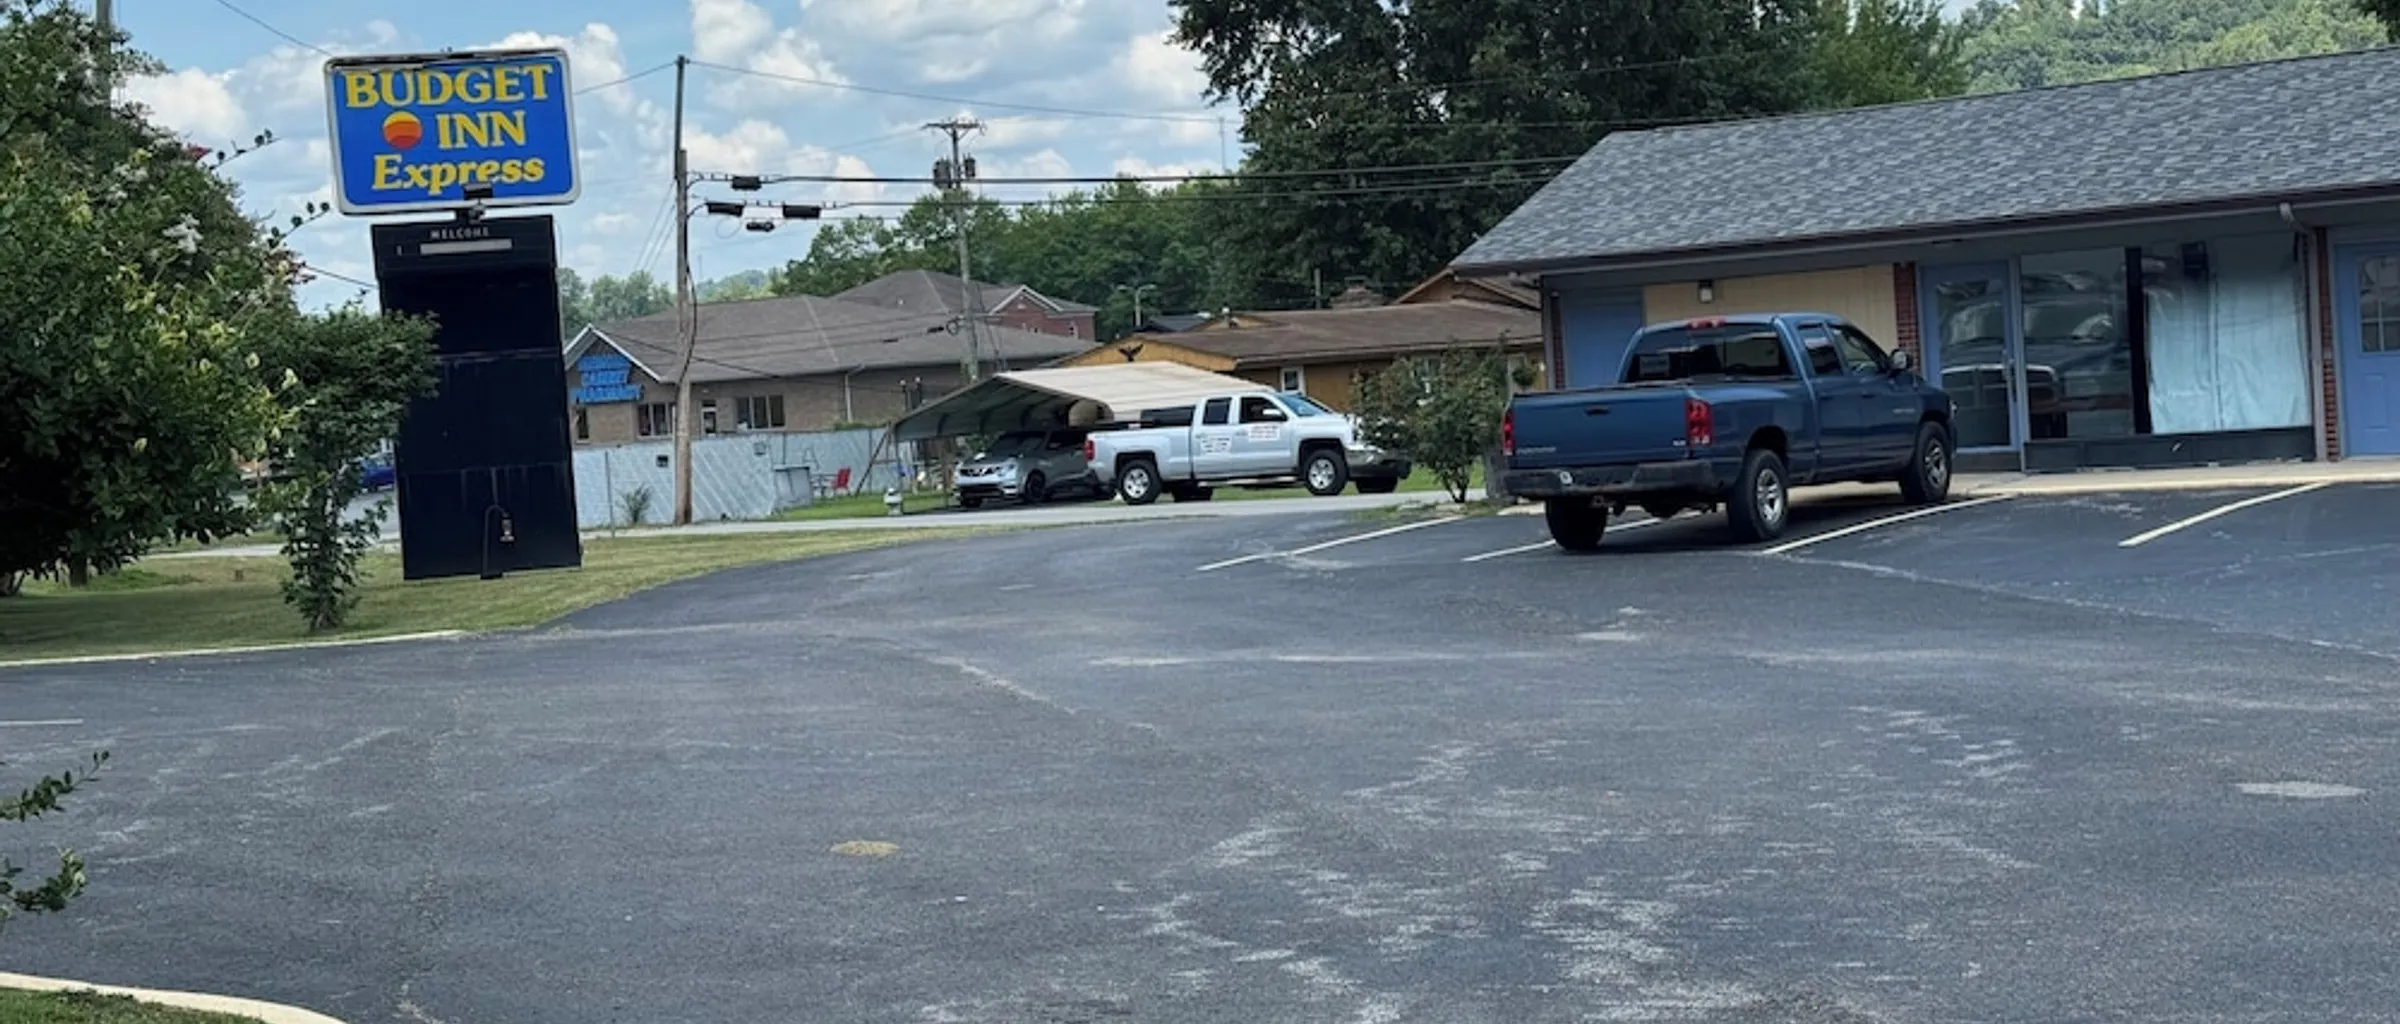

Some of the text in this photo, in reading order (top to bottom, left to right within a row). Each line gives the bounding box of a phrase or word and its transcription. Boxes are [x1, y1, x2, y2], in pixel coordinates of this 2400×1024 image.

[343, 64, 553, 108] BUDGET
[436, 110, 525, 149] INN
[372, 154, 545, 196] Express
[430, 227, 489, 240] WELCOME
